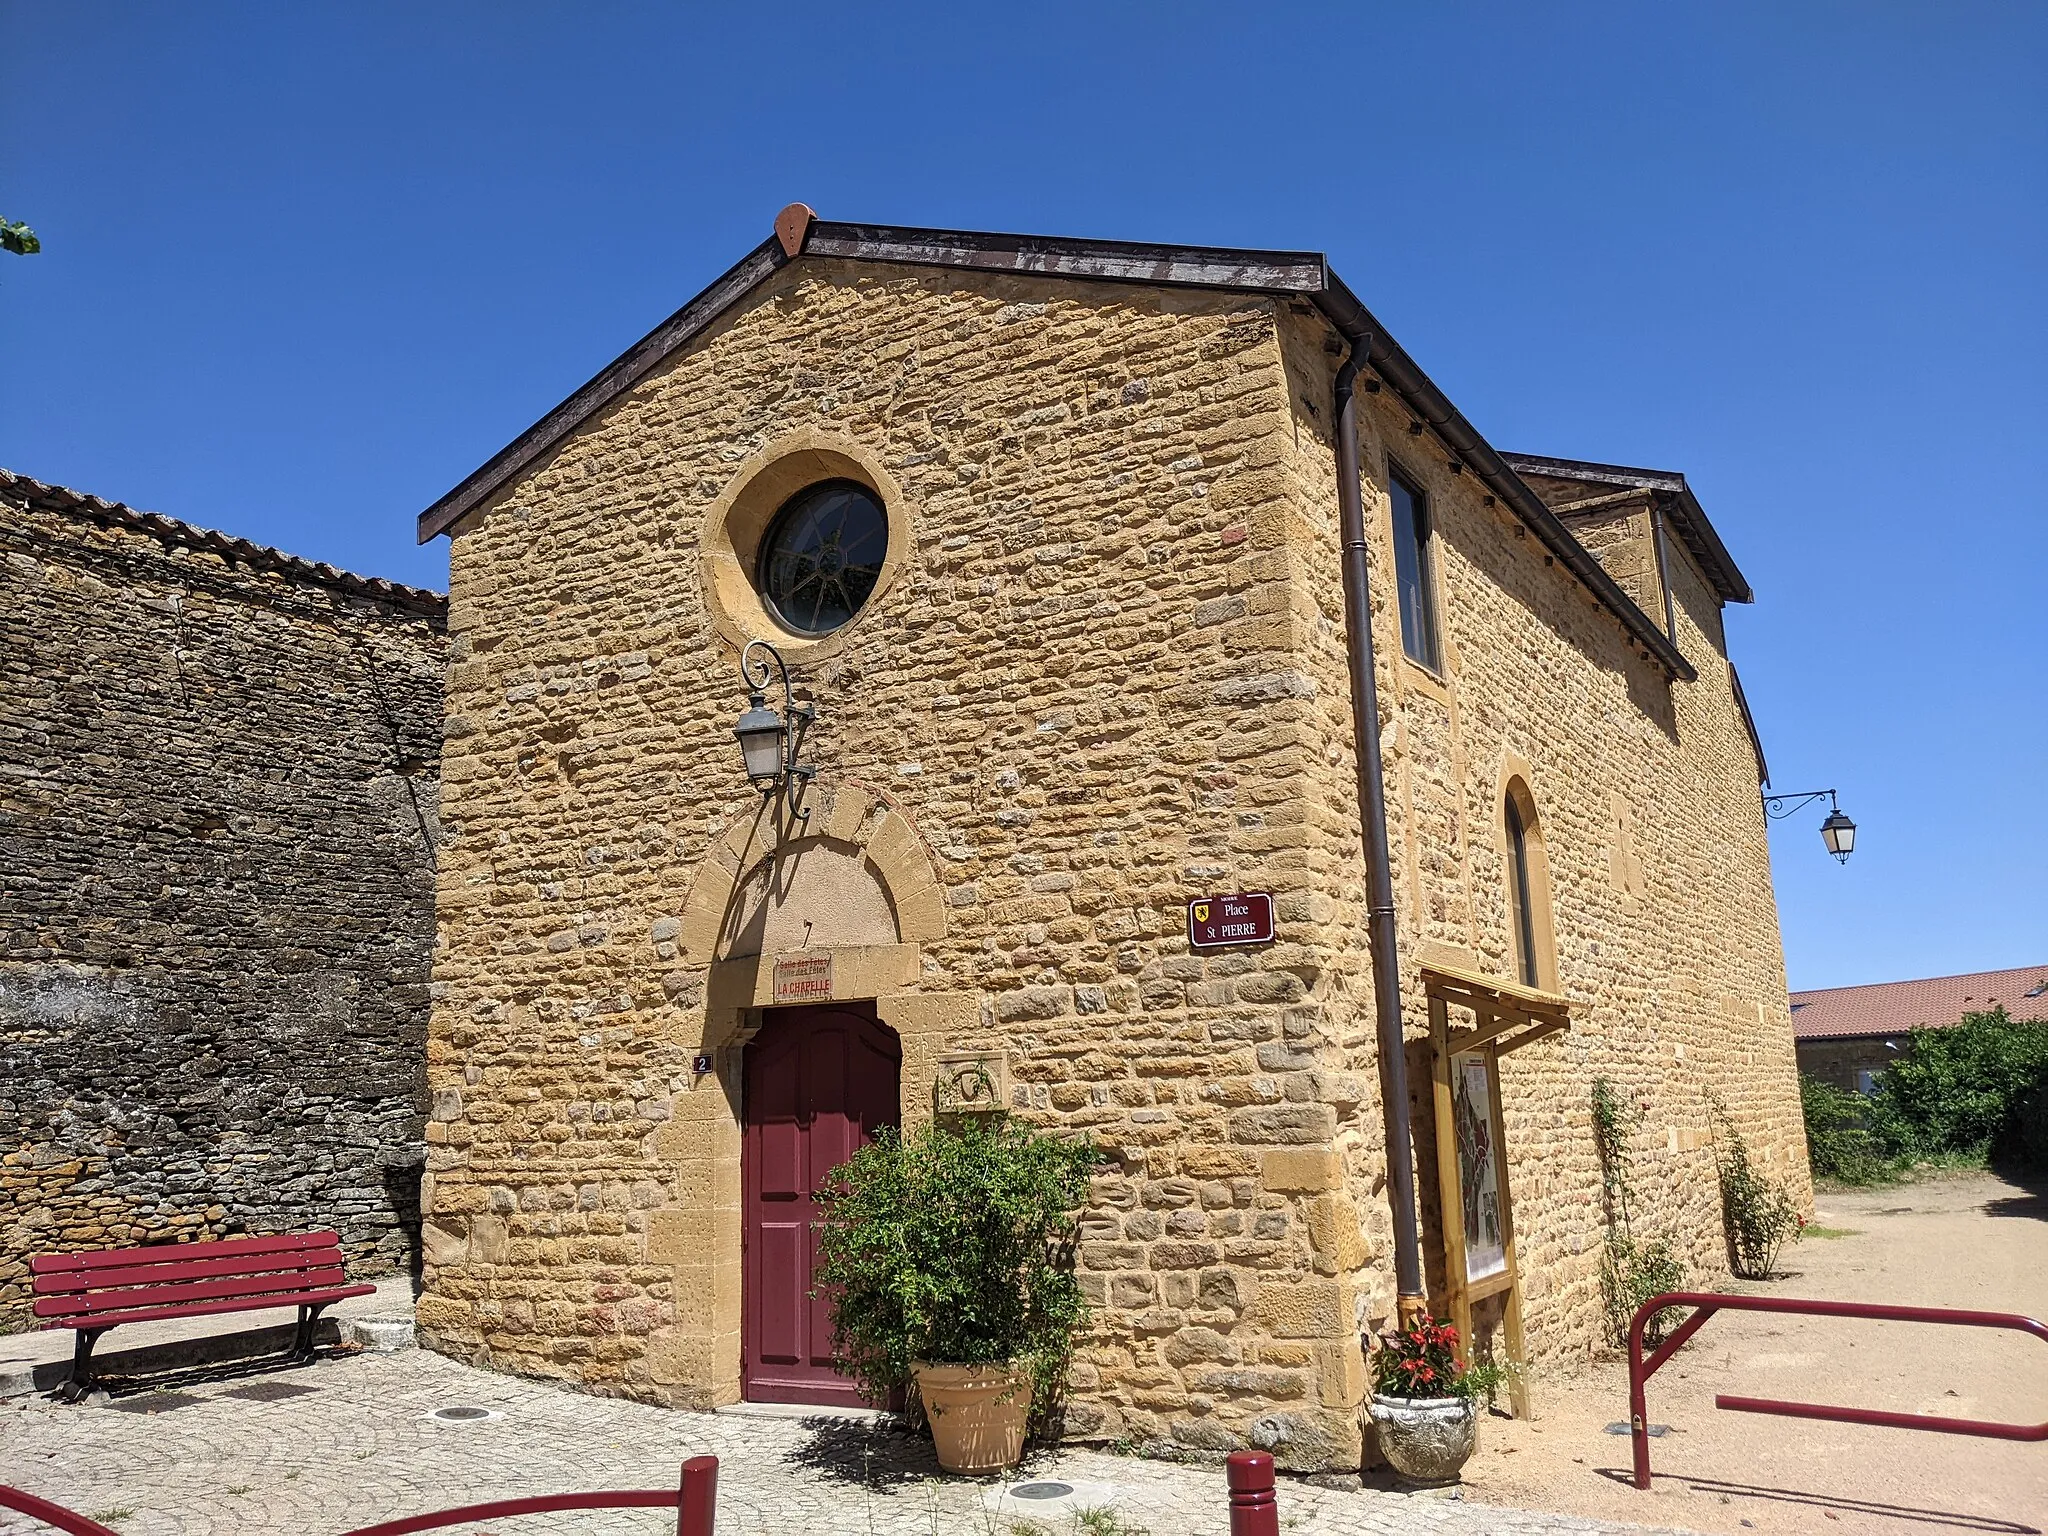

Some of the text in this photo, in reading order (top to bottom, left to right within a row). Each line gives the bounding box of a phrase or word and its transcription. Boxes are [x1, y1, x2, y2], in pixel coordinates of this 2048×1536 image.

[1225, 904, 1249, 916] Place
[1207, 922, 1256, 938] St PIERRE
[780, 960, 795, 969] Salle
[797, 959, 808, 967] des
[778, 980, 830, 995] LA CHAPELLE
[699, 1058, 706, 1070] 2
